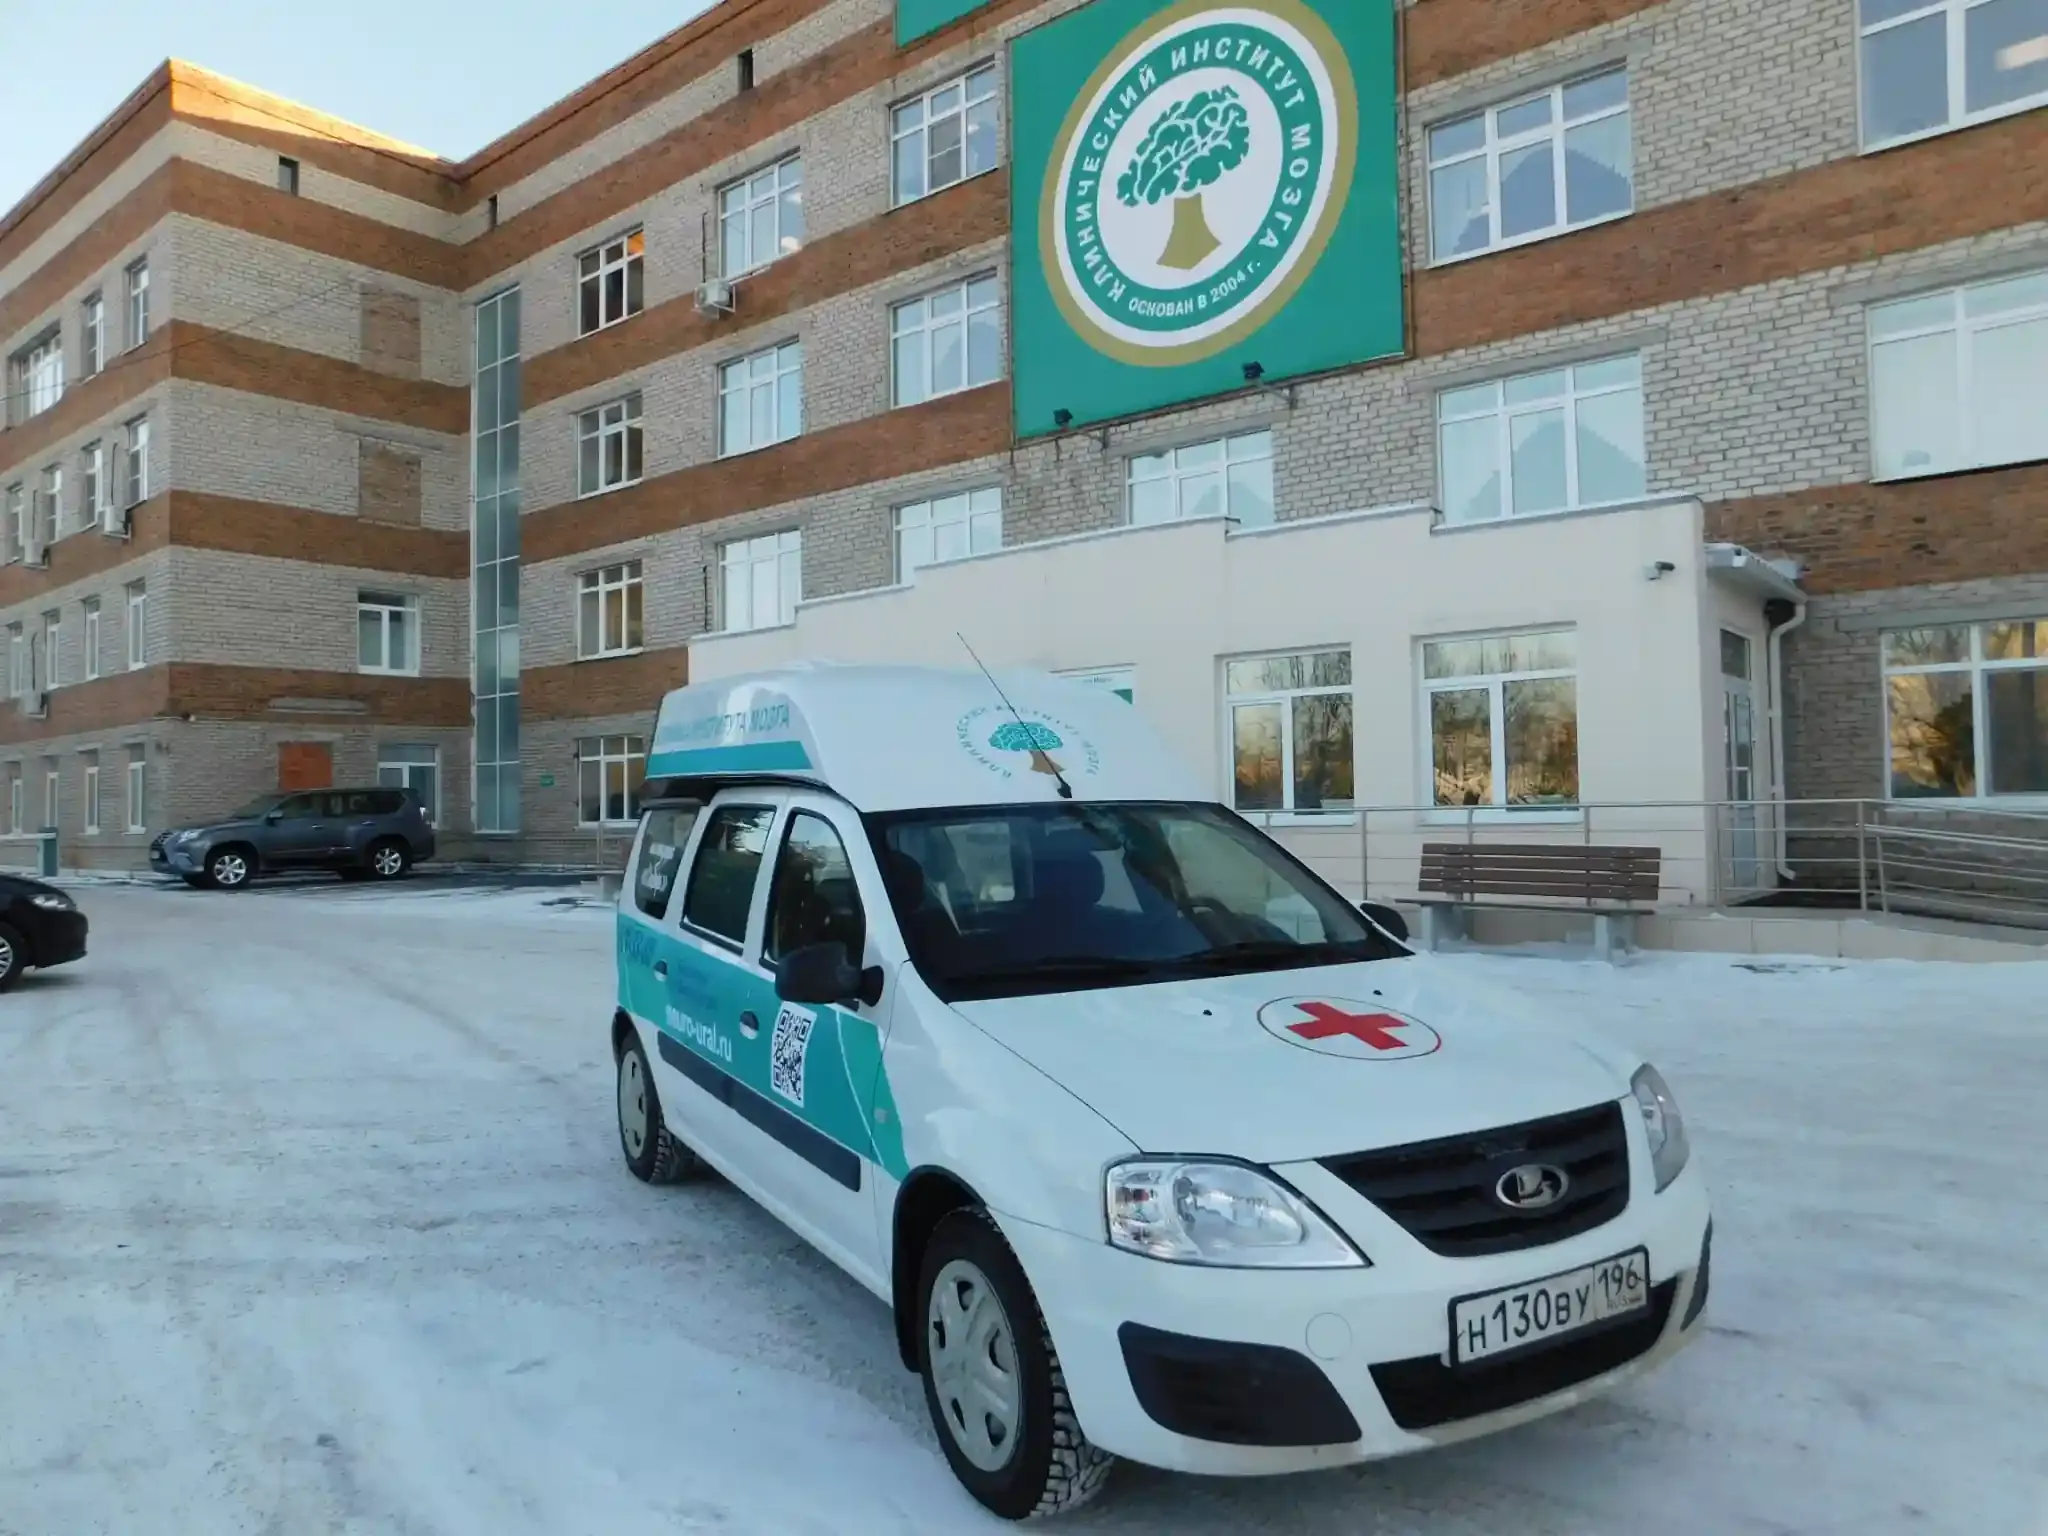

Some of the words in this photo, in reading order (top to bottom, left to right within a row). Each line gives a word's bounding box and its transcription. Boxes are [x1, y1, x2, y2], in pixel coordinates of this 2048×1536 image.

[1075, 63, 1156, 302] КЛИНИЧЕСКИЙ
[1171, 37, 1305, 108] ИНСТИТУТ
[1258, 123, 1312, 248] МОЗГА
[1128, 296, 1194, 317] ОСНОВАН
[1197, 294, 1208, 309] В
[1210, 270, 1246, 303] 2004
[1597, 1257, 1639, 1300] 196
